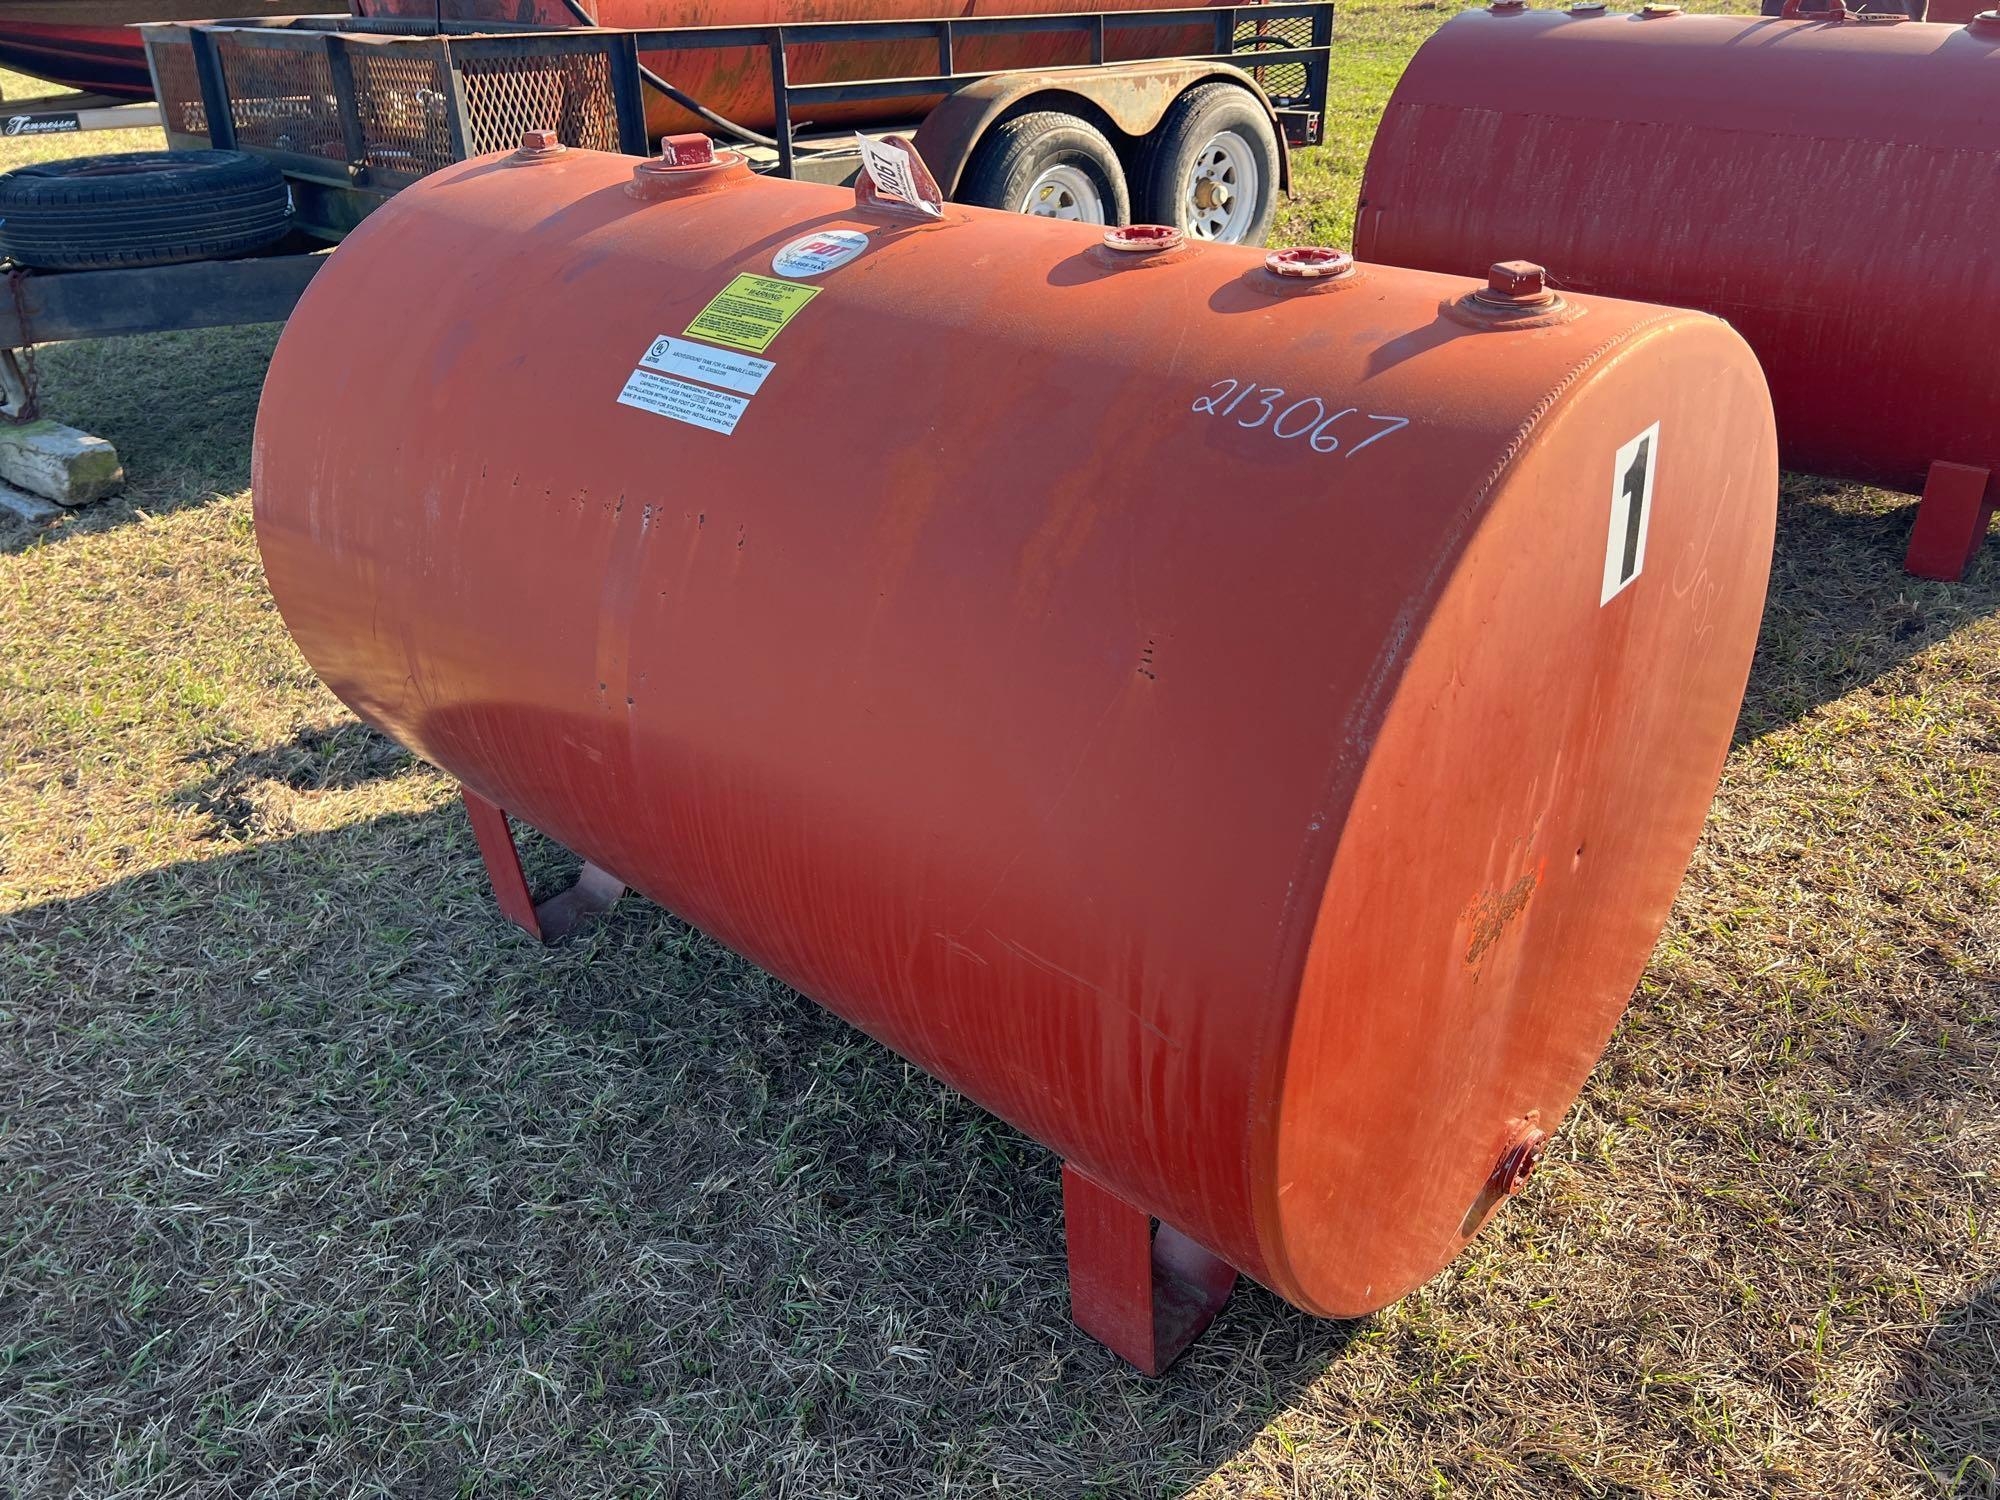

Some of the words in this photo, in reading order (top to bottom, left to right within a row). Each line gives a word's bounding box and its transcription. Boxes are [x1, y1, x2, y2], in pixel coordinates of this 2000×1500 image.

[6, 116, 76, 135] Tennessee
[799, 242, 853, 257] PDT
[748, 289, 784, 300] WARNING!
[673, 352, 702, 362] ABOVEGROUND
[721, 364, 746, 373] FLAMMABLE
[627, 385, 654, 396] INSTALLATION
[640, 381, 659, 389] CAPACITY
[659, 378, 680, 387] REQUIRES
[680, 384, 706, 394] EMERGENCY
[722, 395, 742, 404] VENTING
[637, 396, 657, 405] INTENDED
[666, 404, 692, 415] STATIONARY
[692, 412, 721, 423] INSTALLATION
[1192, 379, 1409, 459] 213067
[1620, 436, 1650, 586] 1
